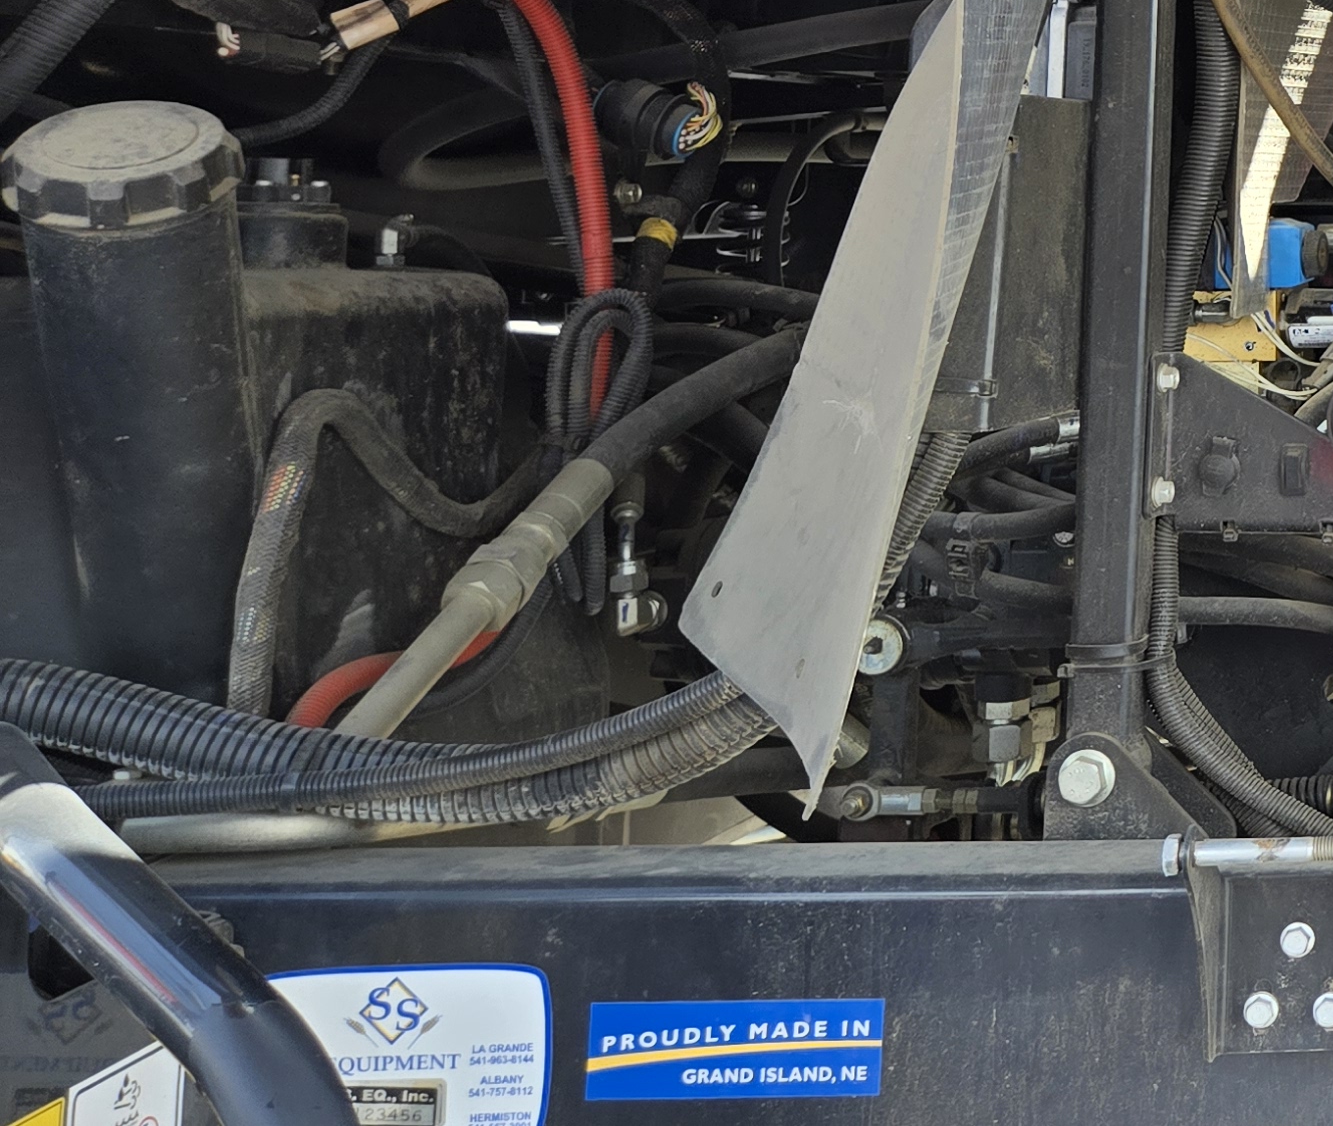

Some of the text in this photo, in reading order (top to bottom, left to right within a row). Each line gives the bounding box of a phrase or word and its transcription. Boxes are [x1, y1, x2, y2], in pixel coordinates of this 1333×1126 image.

[601, 1019, 871, 1053] PROUDLY MADE IN
[472, 1043, 534, 1054] LA GRANDE
[469, 1054, 534, 1066] 541-963-8144
[480, 1075, 524, 1085] ALBANY
[681, 1065, 868, 1085] GRAND ISLAND, NE
[362, 1088, 397, 1103] EQ.,
[401, 1089, 434, 1102] Inc.
[468, 1086, 534, 1098] 541-757-8112
[469, 1111, 532, 1123] HERMISTON
